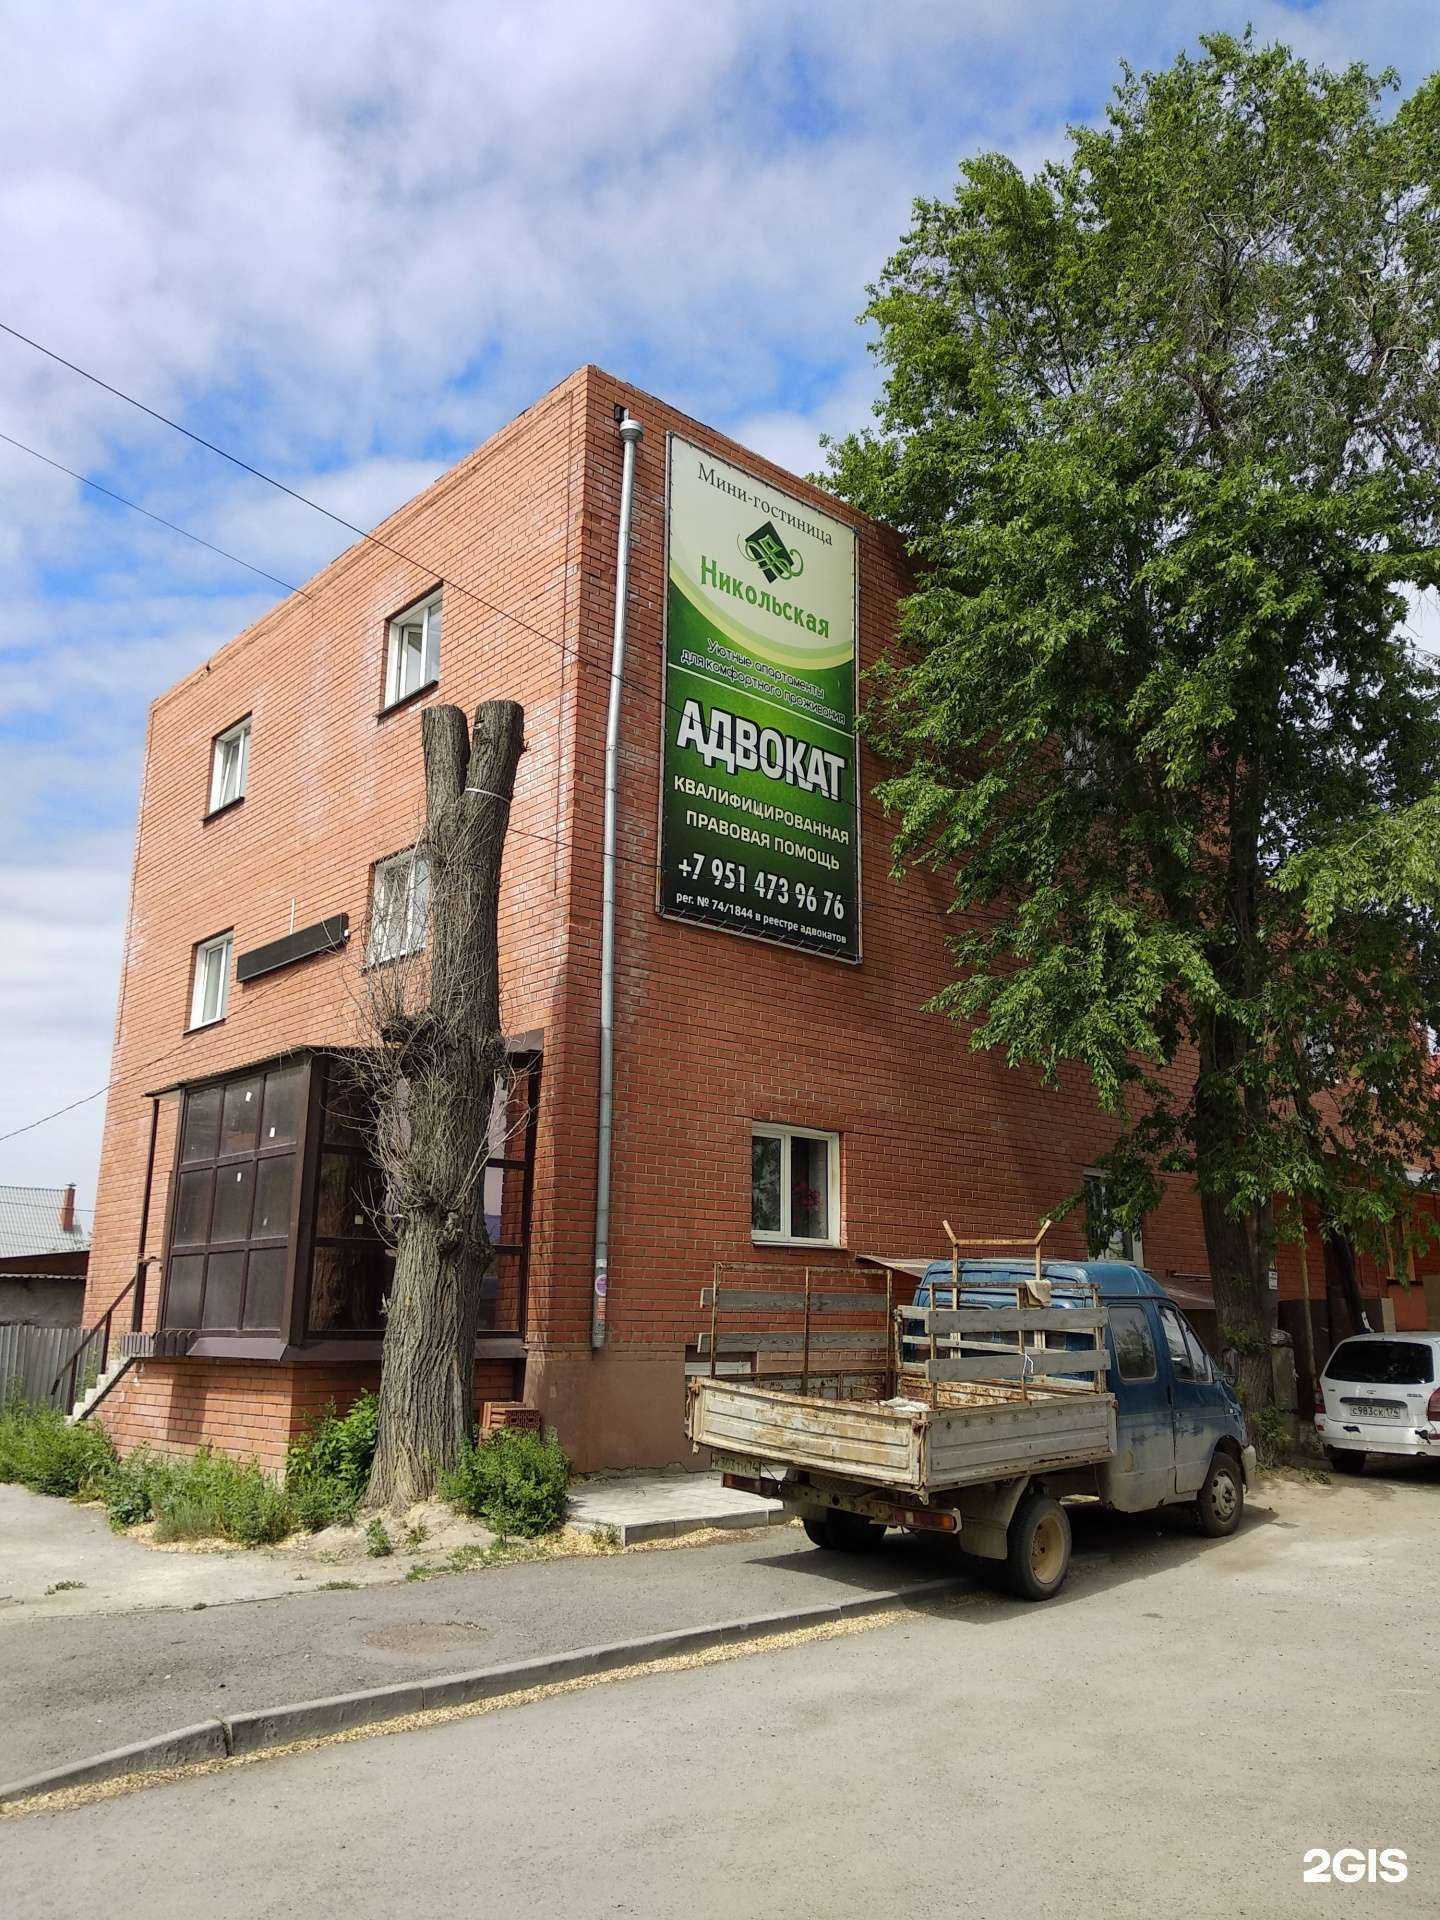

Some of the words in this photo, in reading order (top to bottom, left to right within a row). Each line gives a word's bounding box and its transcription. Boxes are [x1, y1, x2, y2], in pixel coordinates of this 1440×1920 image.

[698, 462, 833, 546] Мини-гостиница
[700, 555, 830, 638] Никольская
[681, 650, 705, 667] для
[705, 656, 783, 697] комфортного
[784, 690, 846, 724] проживания
[707, 638, 753, 667] Уютные
[755, 661, 825, 699] апартаменты
[676, 699, 846, 801] АДВОКАТ
[674, 775, 850, 846] КВАЛИФИЦИРОВАННАЯ
[686, 810, 770, 848] ПРАВОВАЯ
[774, 836, 840, 871] ПОМОЩЬ
[676, 892, 695, 904] рег.
[697, 895, 710, 908] №
[712, 899, 754, 919] 74/1844
[755, 912, 761, 922] в
[763, 914, 799, 932] реестре
[800, 925, 847, 944] адвокатов
[678, 853, 706, 881] +7
[711, 858, 746, 893] 951
[754, 871, 789, 904] 473
[795, 883, 818, 912] 96
[823, 890, 845, 920] 76
